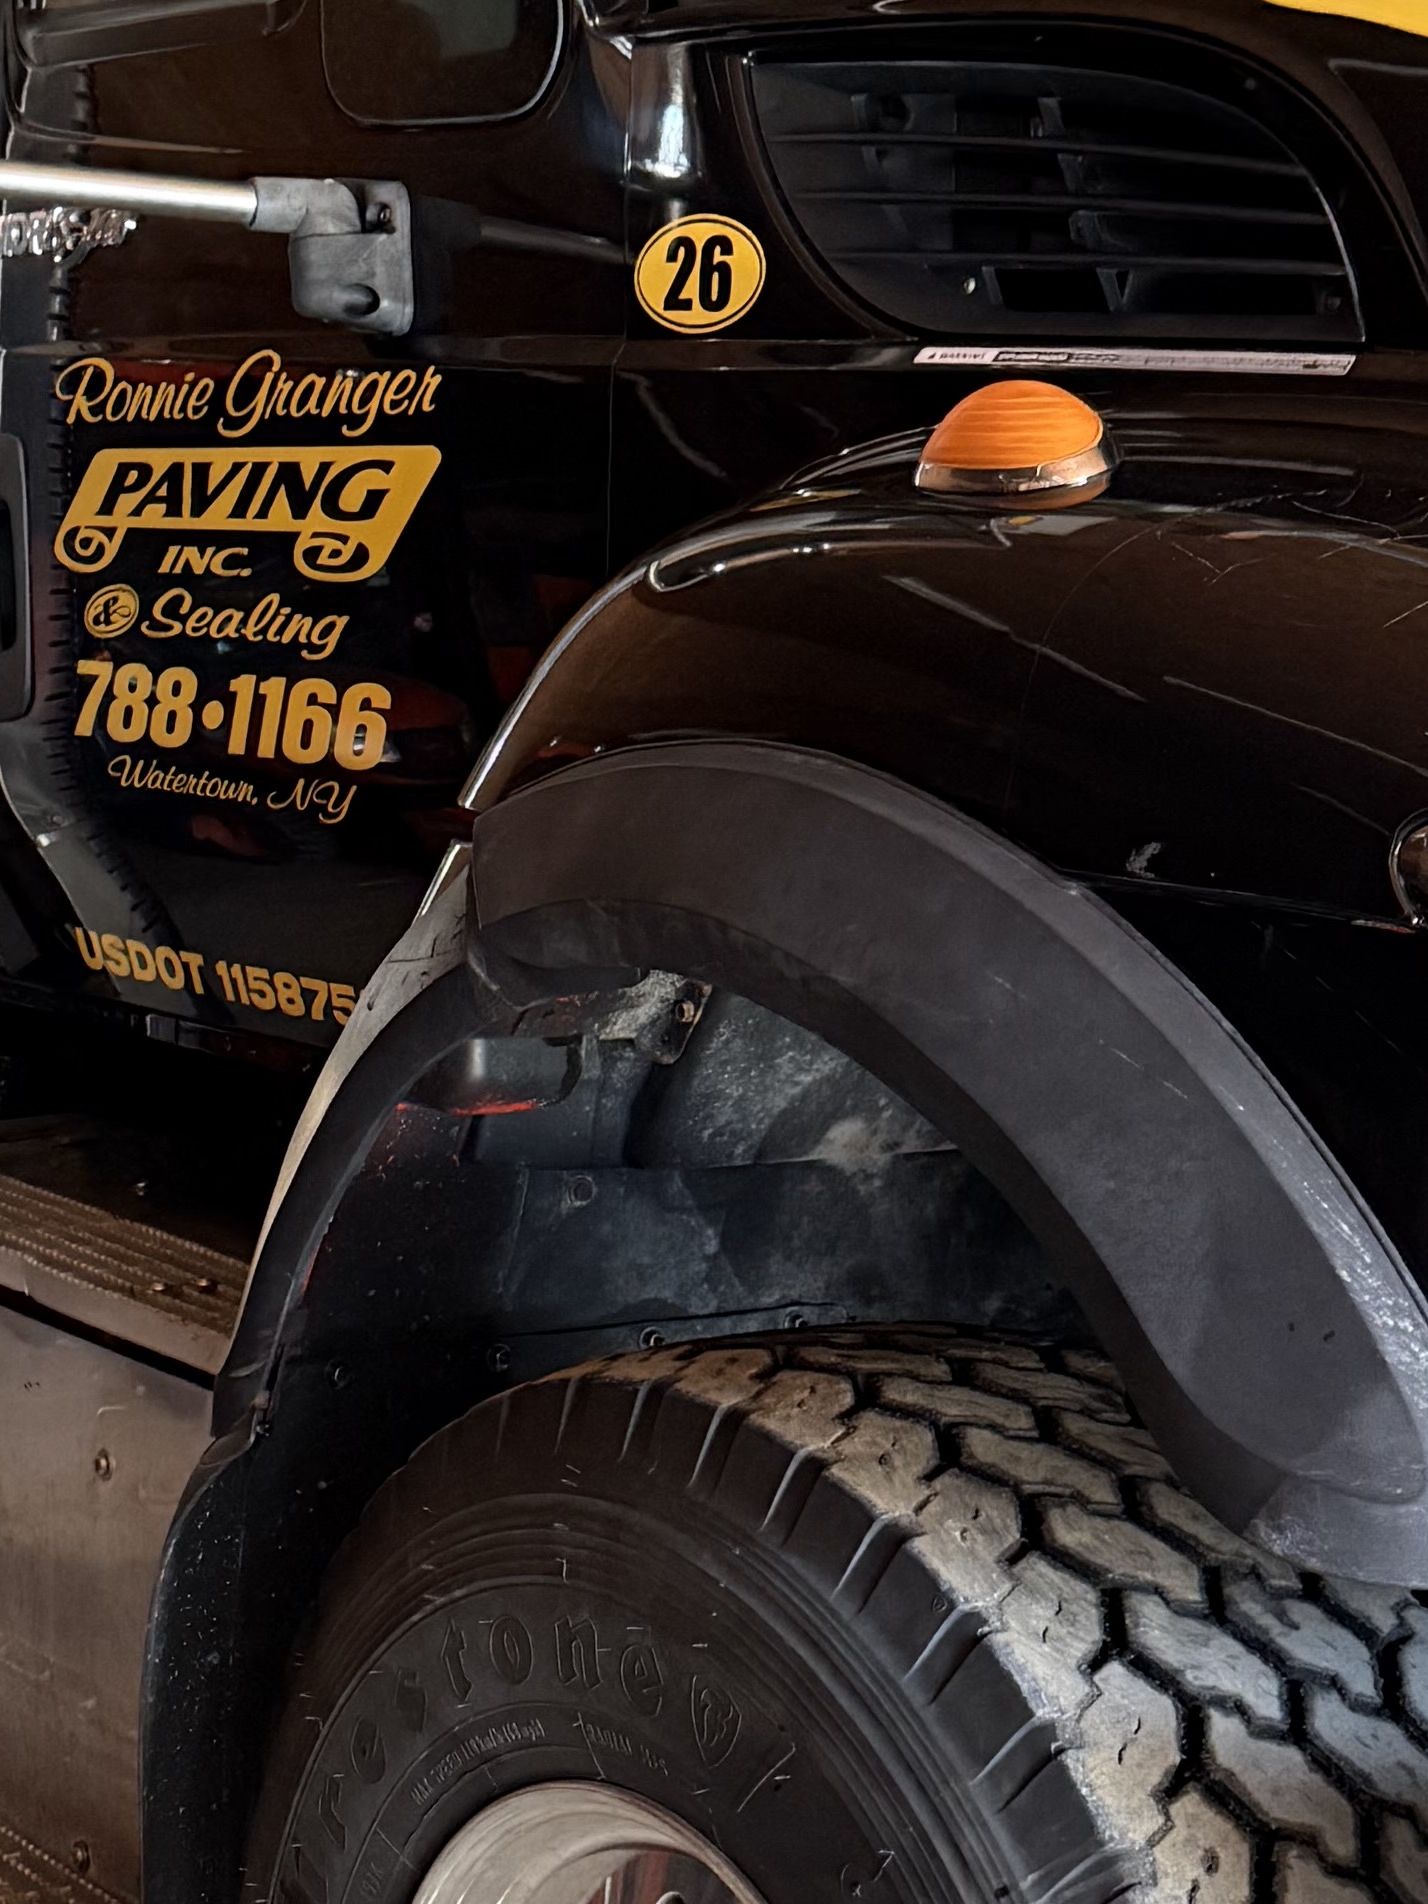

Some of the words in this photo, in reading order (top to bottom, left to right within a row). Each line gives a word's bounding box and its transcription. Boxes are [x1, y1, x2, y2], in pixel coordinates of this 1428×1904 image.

[663, 234, 734, 313] 26
[54, 356, 215, 425] Ronnie
[216, 348, 443, 438] Granger
[94, 459, 397, 523] PAVING
[157, 545, 253, 578] INC.
[87, 589, 136, 633] &
[140, 587, 350, 661] Sealing
[266, 778, 358, 825] NY
[74, 926, 205, 995] USDOT
[216, 959, 366, 1027] 115875
